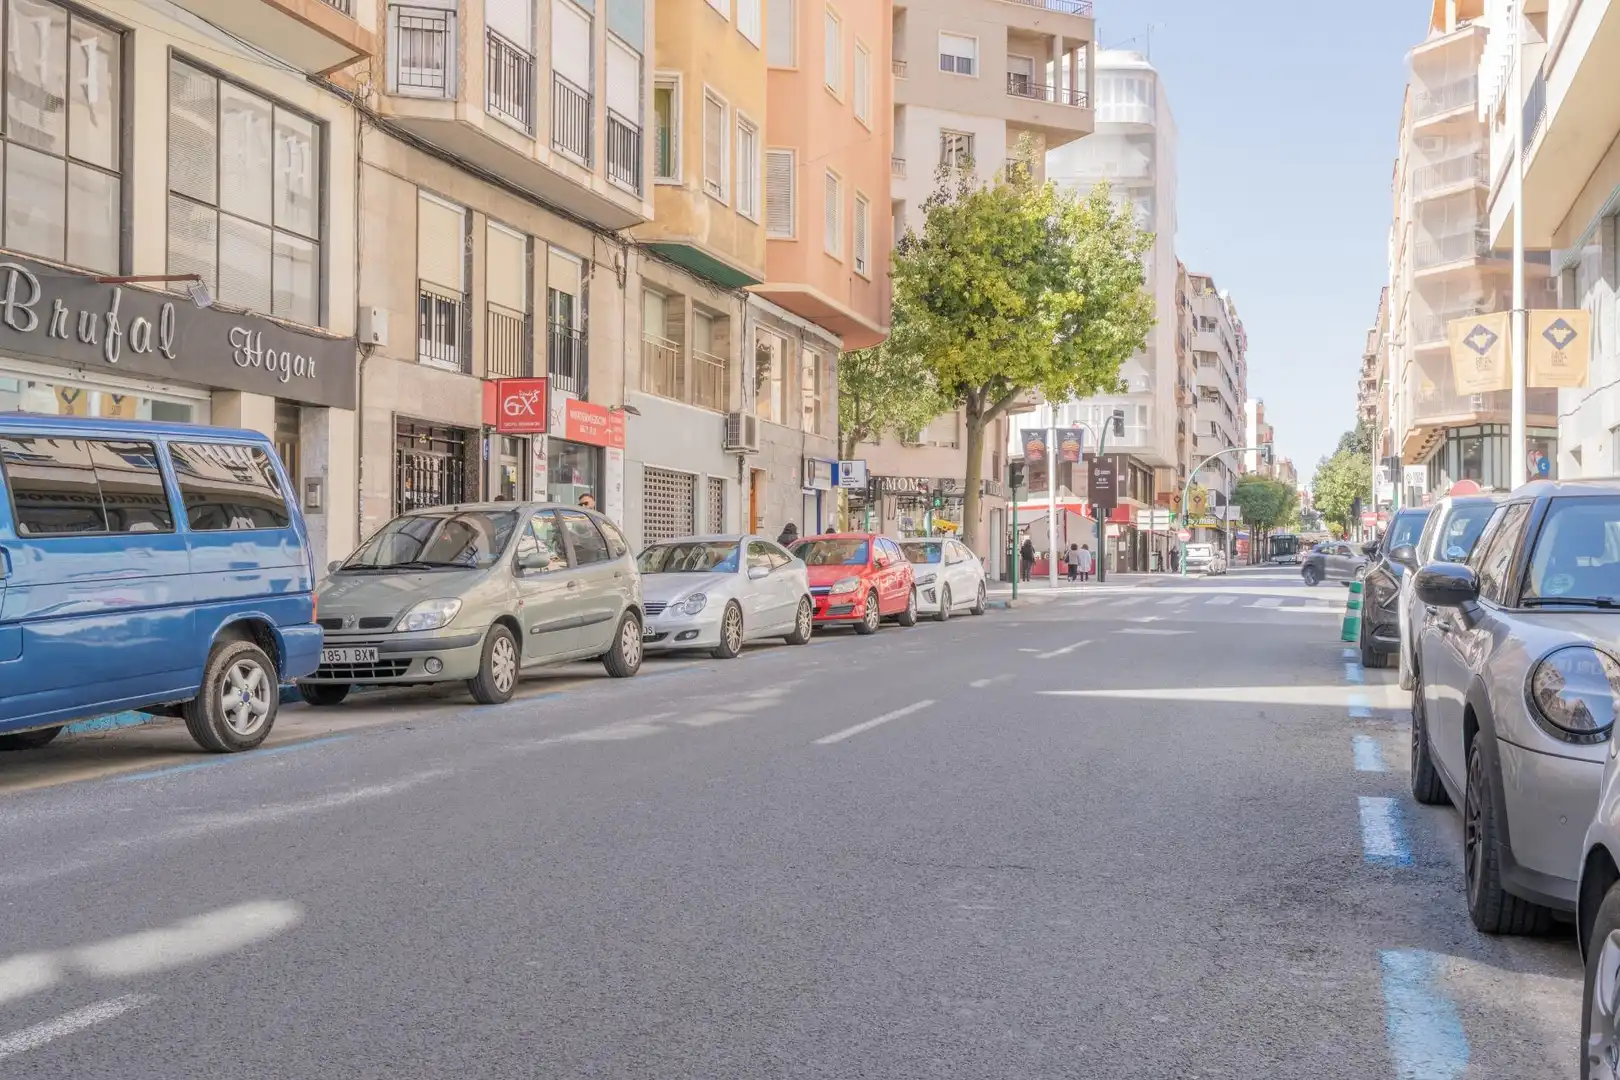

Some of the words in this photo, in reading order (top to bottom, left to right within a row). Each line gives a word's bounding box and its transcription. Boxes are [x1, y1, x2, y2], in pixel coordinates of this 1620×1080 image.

[0, 262, 176, 363] Brufal
[230, 326, 316, 383] Hogar
[322, 650, 347, 661] 1851
[354, 649, 375, 662] BXW
